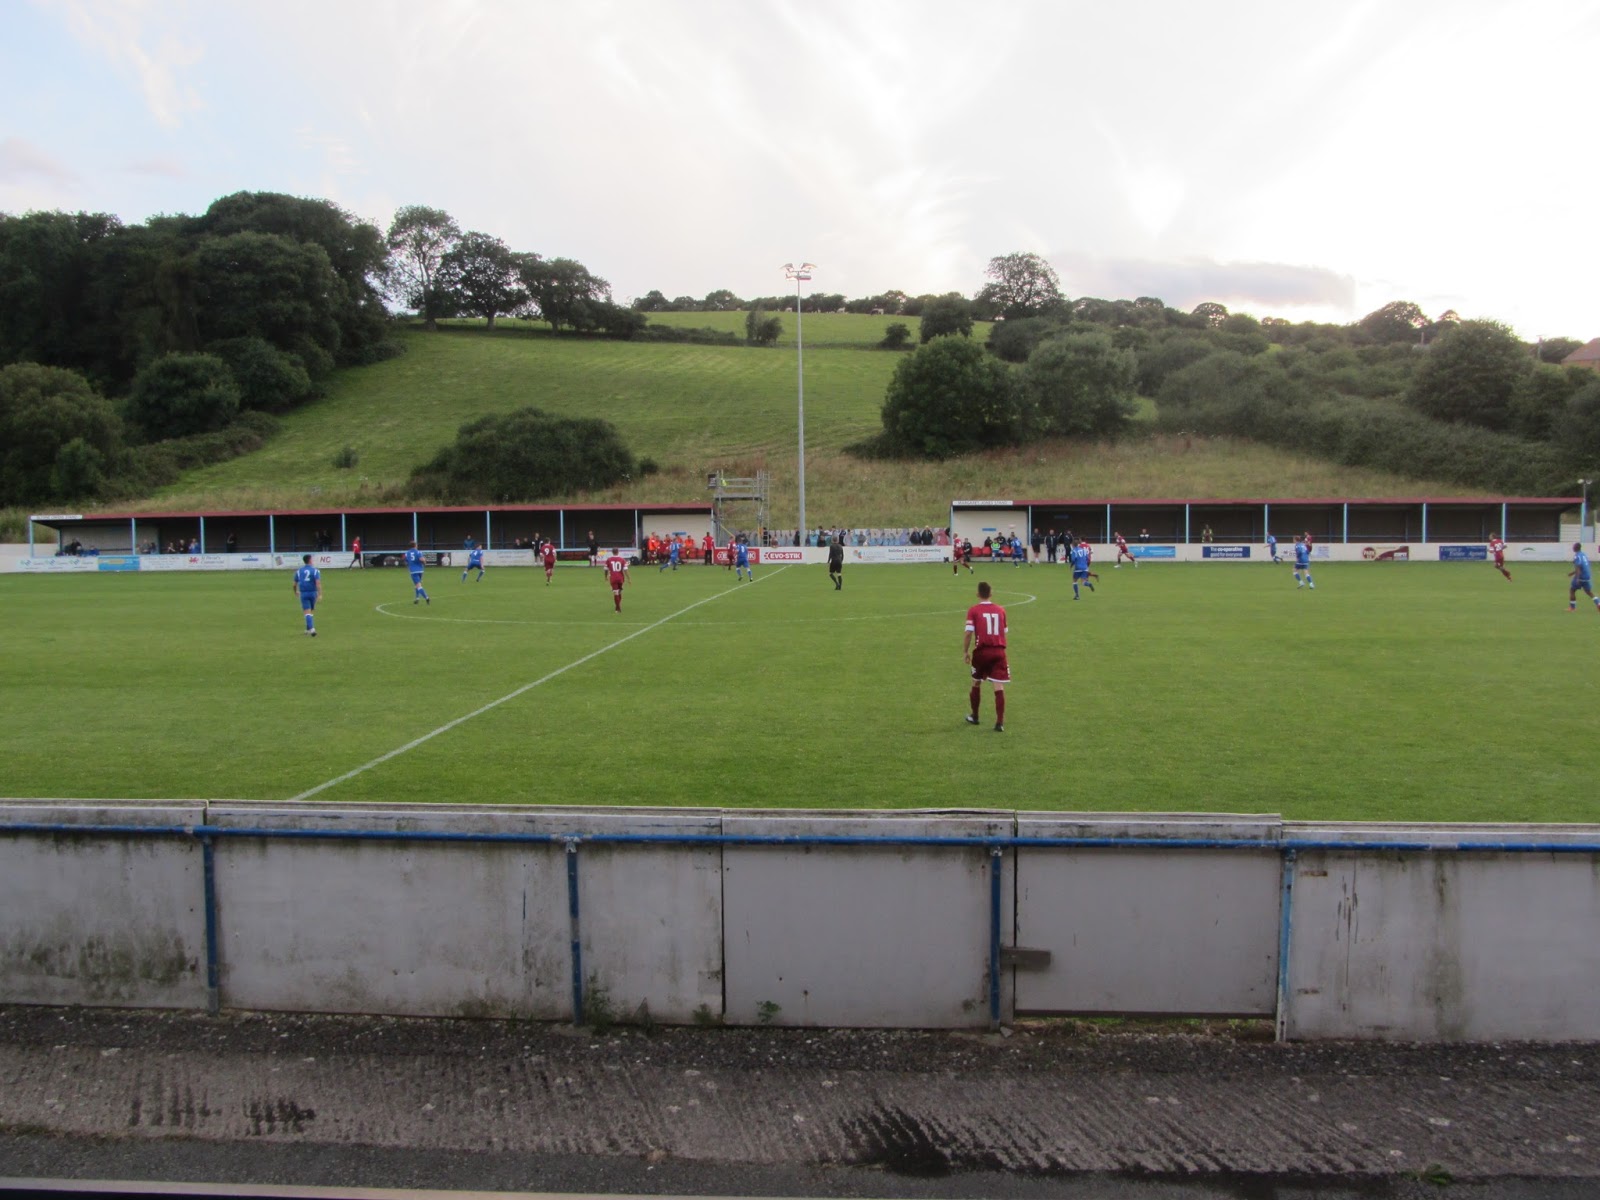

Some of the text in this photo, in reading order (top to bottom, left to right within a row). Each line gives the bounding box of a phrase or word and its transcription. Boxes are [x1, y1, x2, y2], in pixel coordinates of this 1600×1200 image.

[544, 547, 550, 555] 9
[770, 552, 801, 560] EVO-STIK
[410, 552, 415, 561] 5
[610, 561, 621, 572] 10
[304, 569, 311, 581] 2
[982, 613, 999, 635] 11
